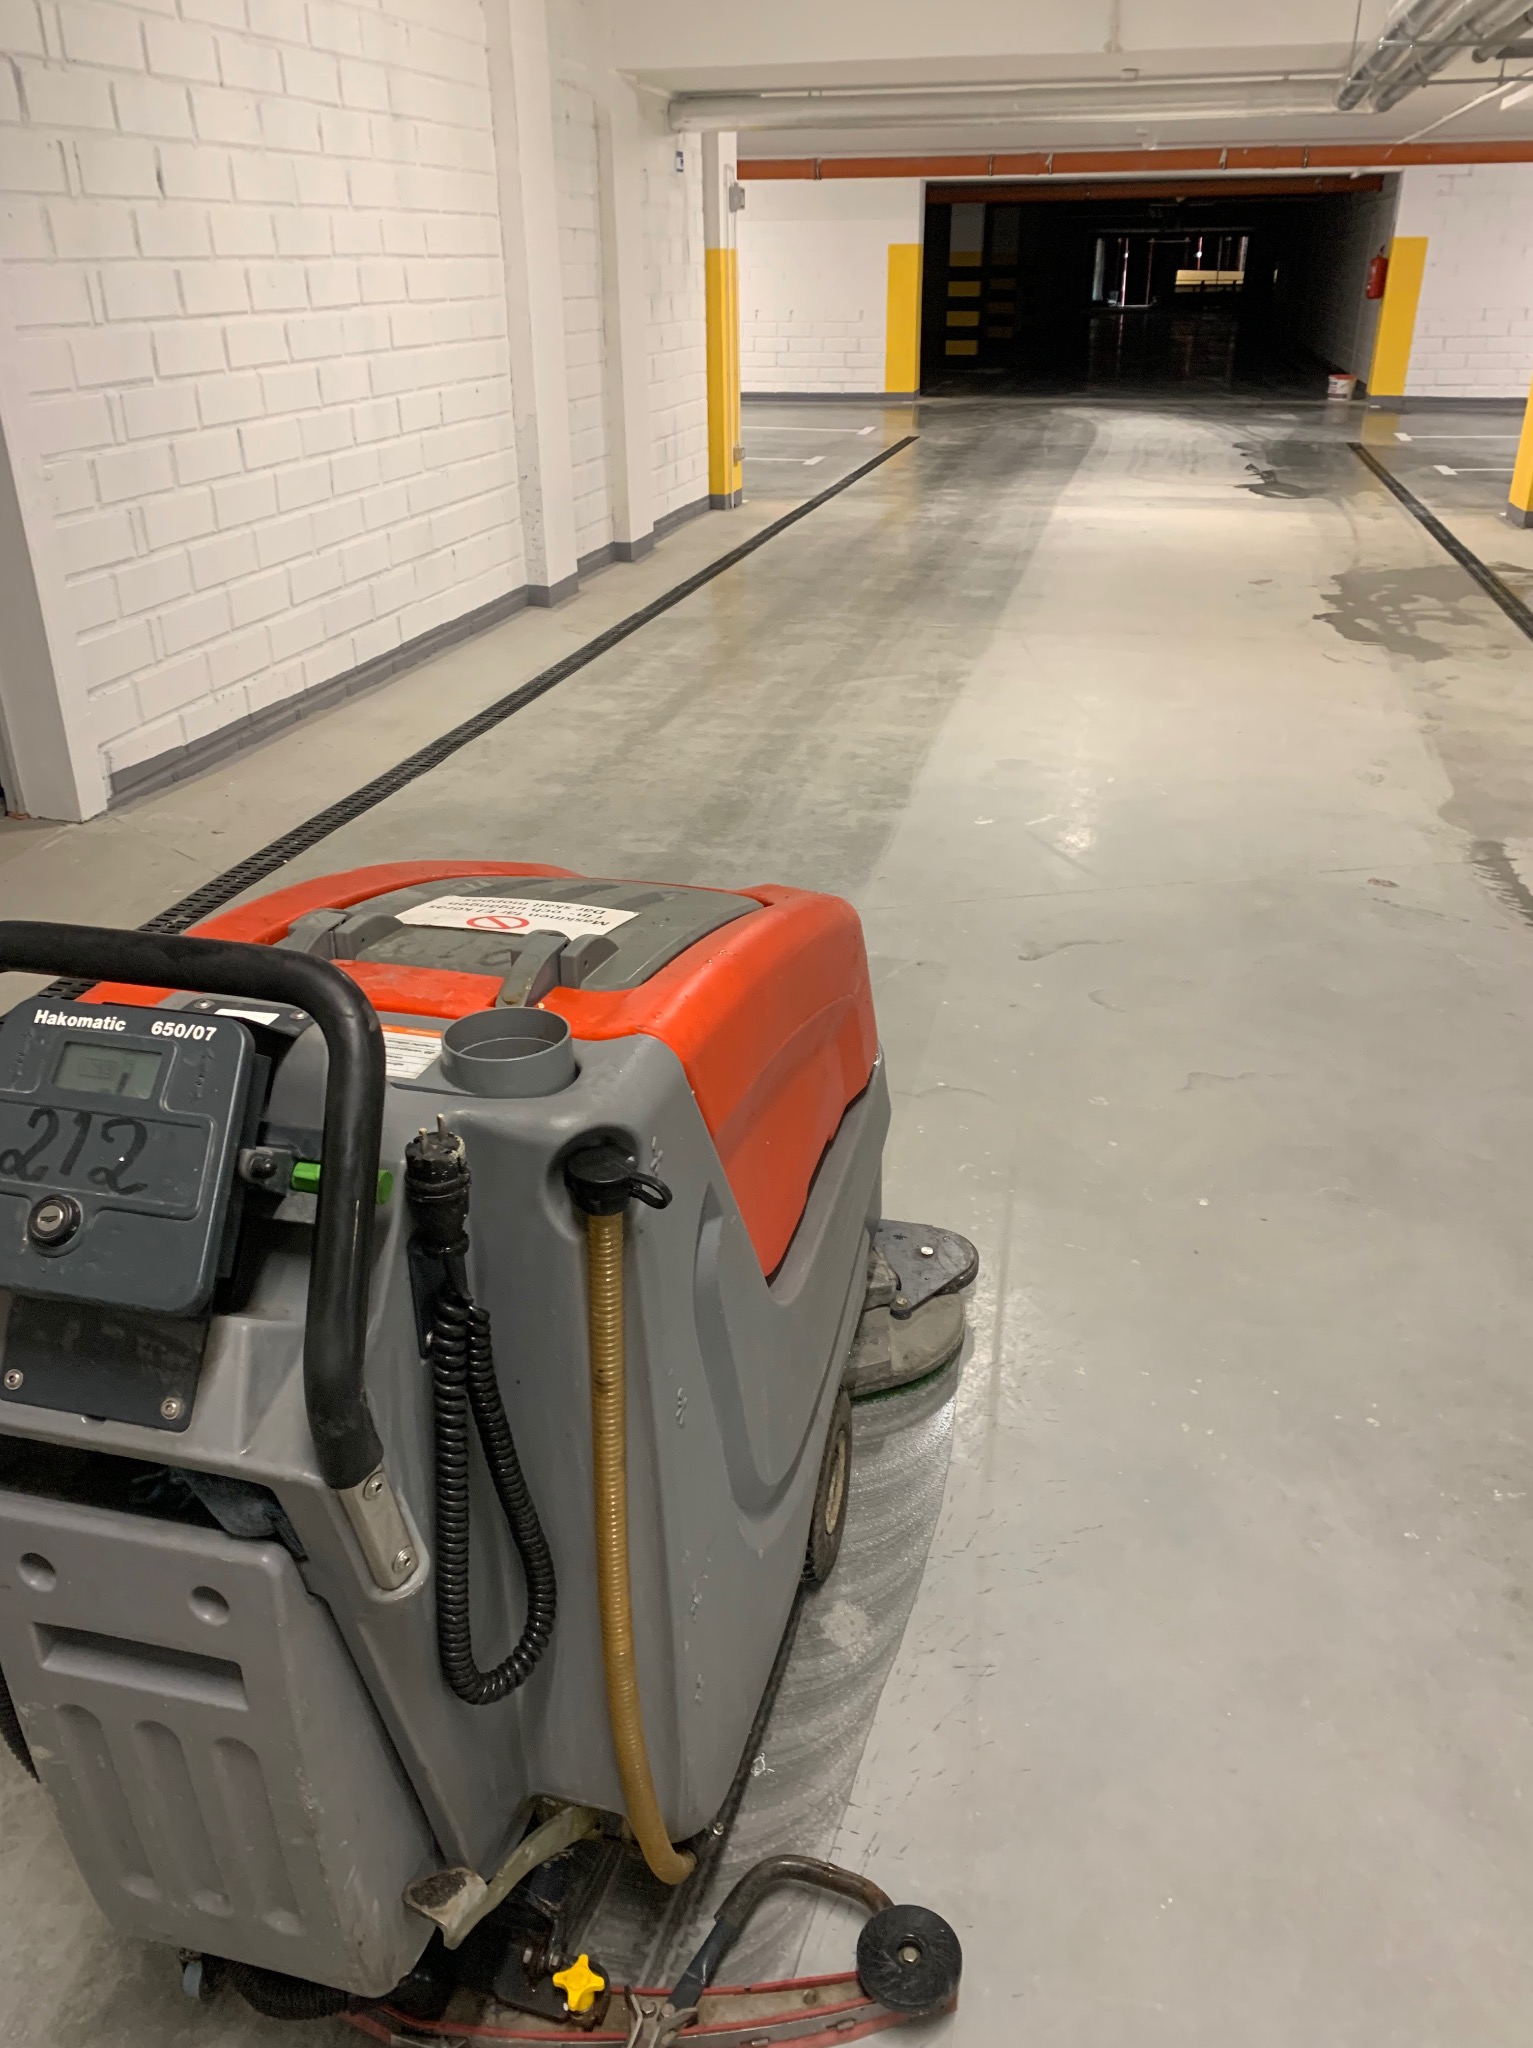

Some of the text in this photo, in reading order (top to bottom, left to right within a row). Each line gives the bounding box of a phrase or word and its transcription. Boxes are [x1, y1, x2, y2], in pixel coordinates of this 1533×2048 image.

[447, 902, 527, 911] utgången
[575, 907, 607, 915] Där
[528, 912, 610, 926] Maskinen
[34, 1009, 217, 1042] Hakomatic 650/07
[0, 1107, 149, 1195] 212
